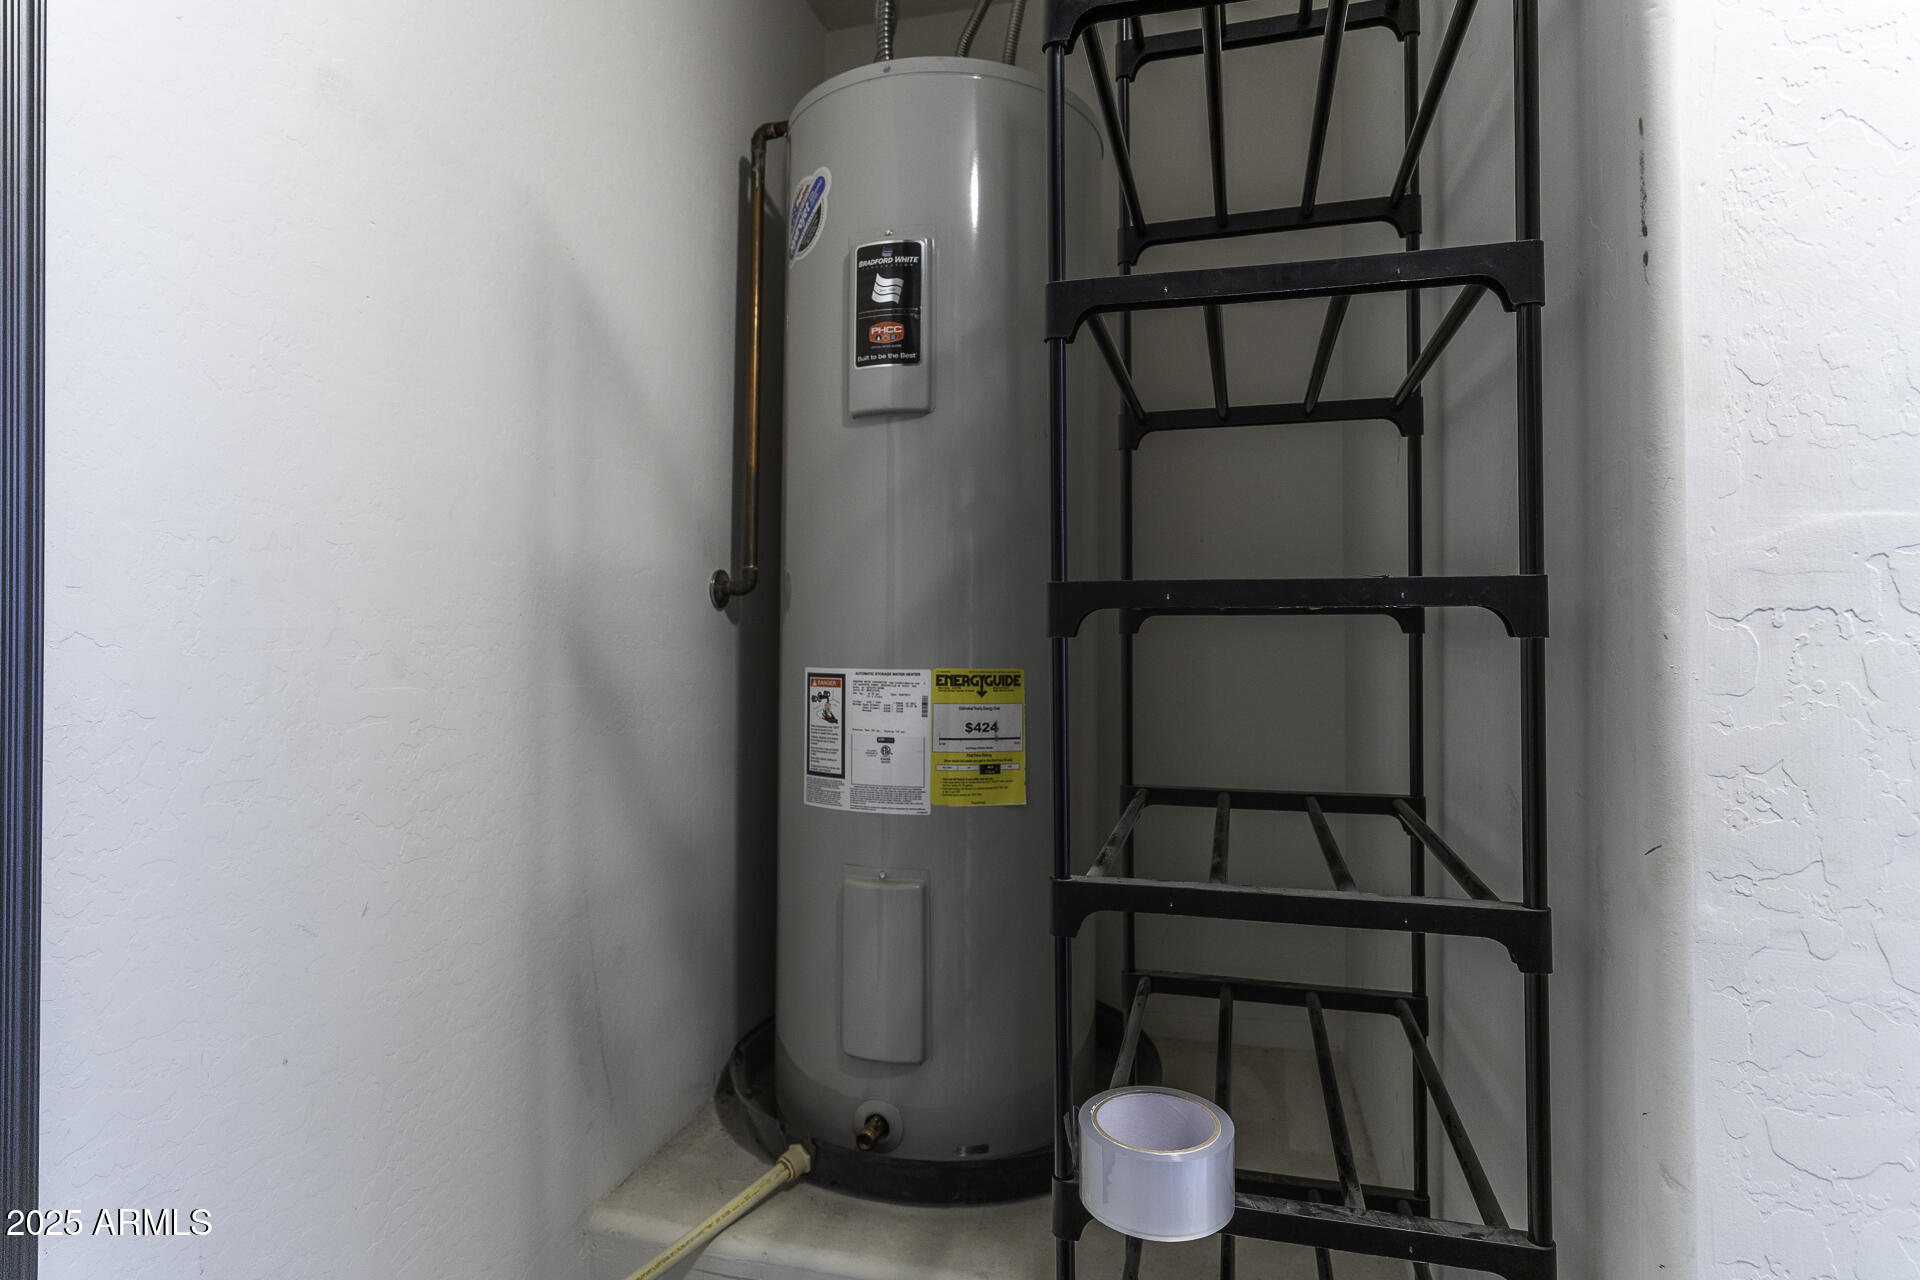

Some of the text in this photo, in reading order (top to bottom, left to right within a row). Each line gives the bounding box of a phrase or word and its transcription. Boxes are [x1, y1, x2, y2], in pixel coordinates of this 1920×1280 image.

[858, 257, 894, 268] BRADFORD
[894, 256, 919, 264] WHITE
[871, 325, 903, 334] PHCC
[936, 674, 1022, 688] ENERGYGUIDE
[965, 721, 999, 733] $424
